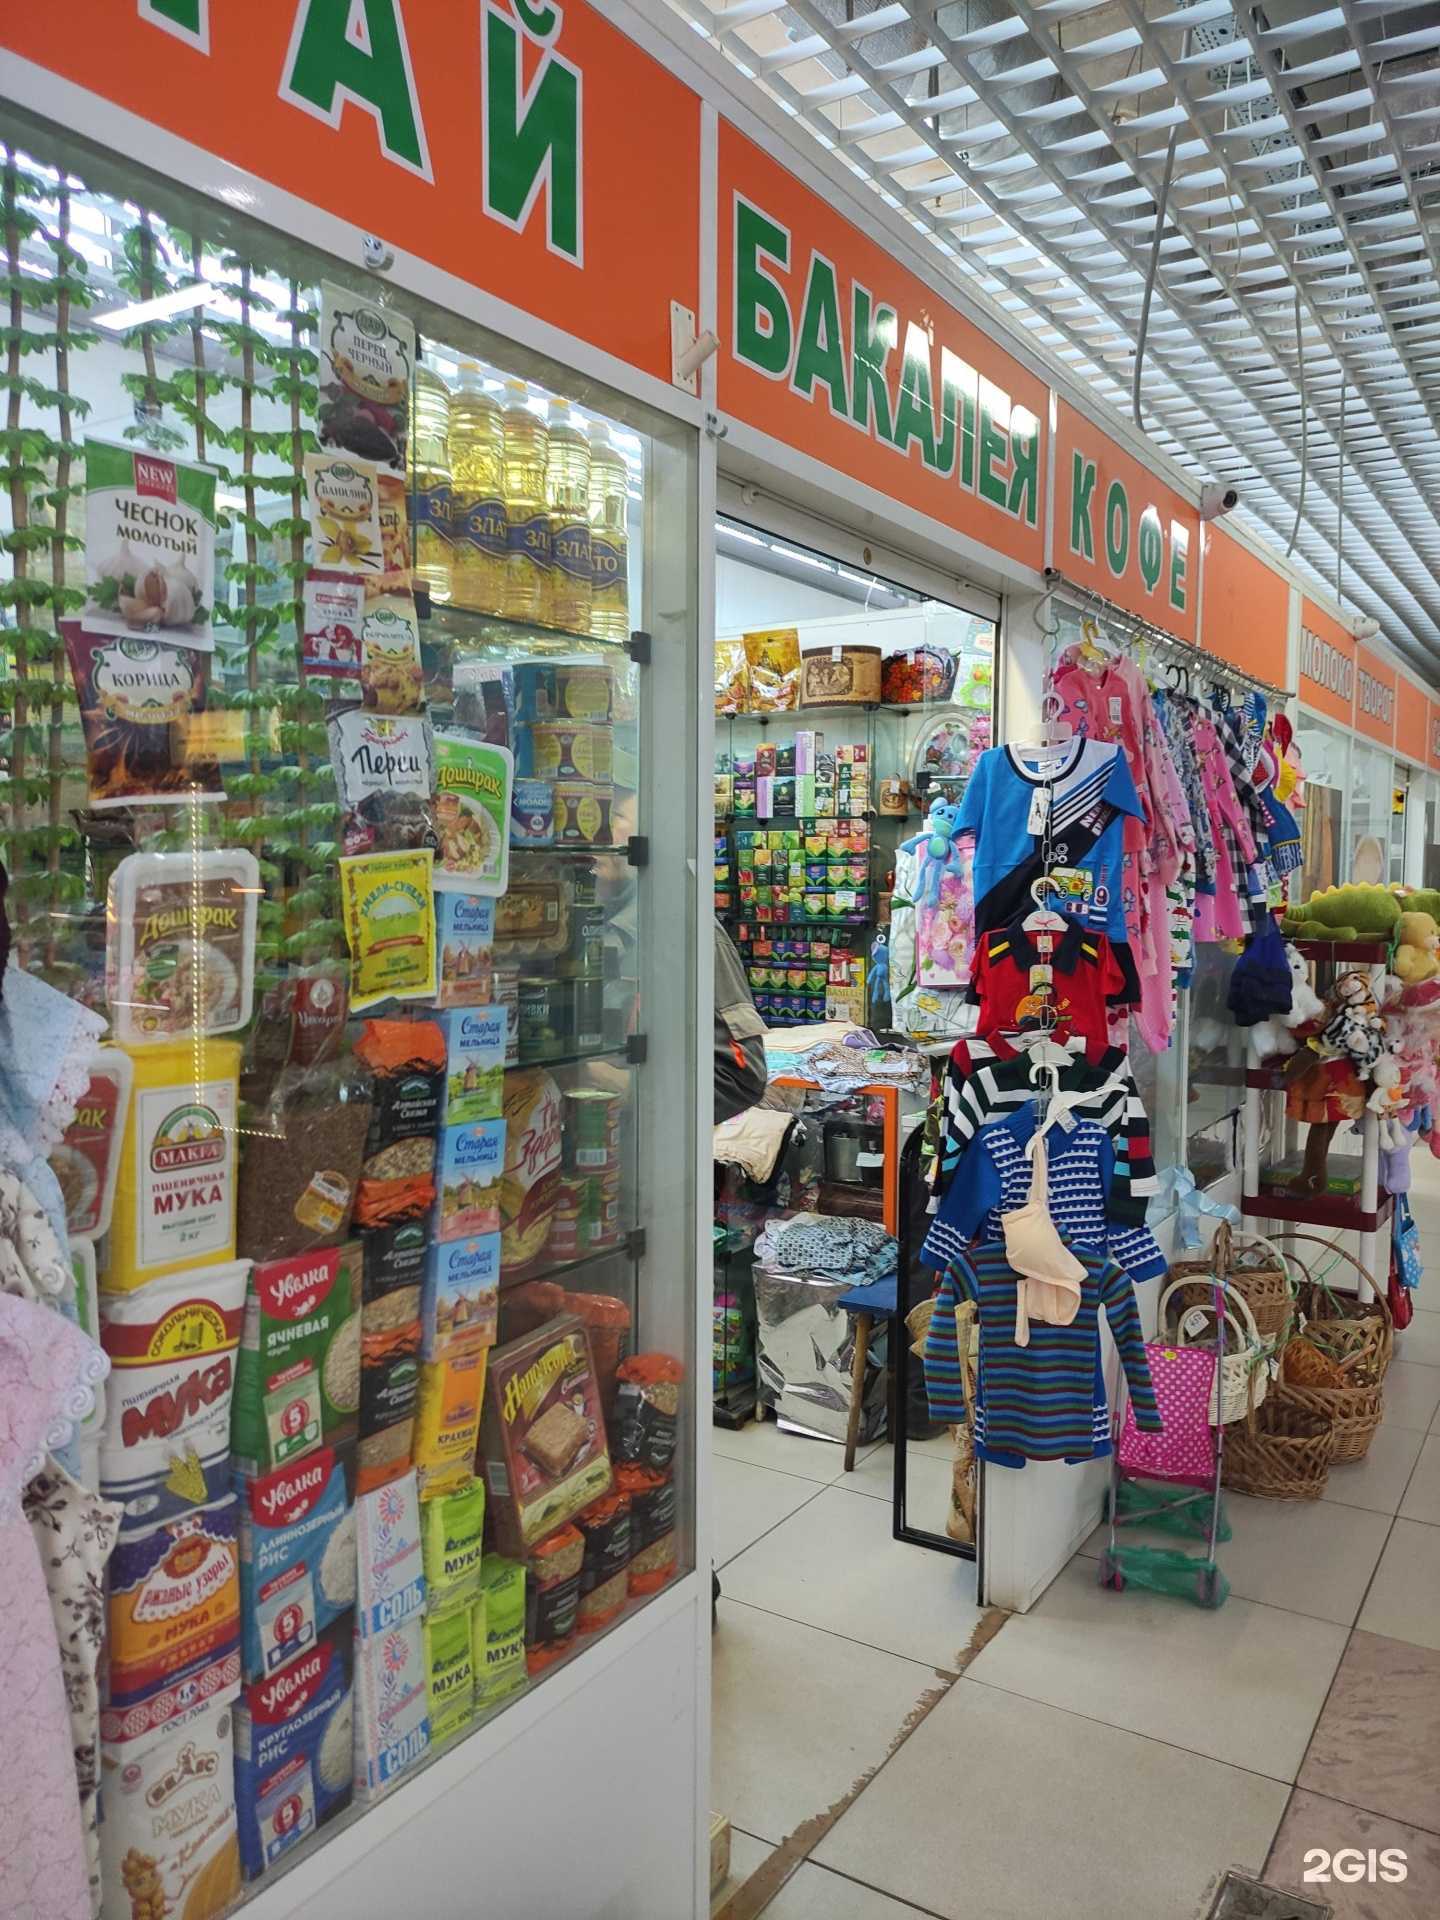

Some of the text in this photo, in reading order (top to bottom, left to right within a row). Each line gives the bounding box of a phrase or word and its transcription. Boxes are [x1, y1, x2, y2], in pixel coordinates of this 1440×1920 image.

[138, 0, 583, 268] АЙ
[732, 188, 1041, 531] БАКАЛЕЯ
[137, 463, 173, 484] NEW
[115, 498, 199, 536] ЧЕСНОК
[1069, 446, 1190, 613] КОФЕ
[116, 524, 197, 555] МОЛОТЫЙ
[1300, 624, 1353, 703] МОЛОКО
[112, 672, 181, 688] КОРИЦА
[139, 906, 237, 946] Доширак
[461, 1016, 500, 1035] Старая
[456, 1134, 498, 1152] Старая
[152, 1171, 225, 1193] ПШЕНИЧНАЯ
[153, 1184, 223, 1216] МУКА
[449, 1250, 491, 1269] Старая
[270, 1265, 329, 1307] Увелка
[267, 1316, 330, 1347] ЯЧНЕВАЯ
[290, 1407, 301, 1425] 5
[261, 1466, 323, 1516] Увелка
[258, 1547, 290, 1571] РИС
[379, 1585, 423, 1627] СОЛЬ
[282, 1612, 295, 1632] 5
[260, 1656, 321, 1713] Увелка
[432, 1664, 470, 1695] МУКА
[258, 1689, 342, 1752] КРУГЛОЗЕРНЫЙ
[258, 1740, 289, 1769] РИС
[386, 1727, 428, 1775] СОЛЬ
